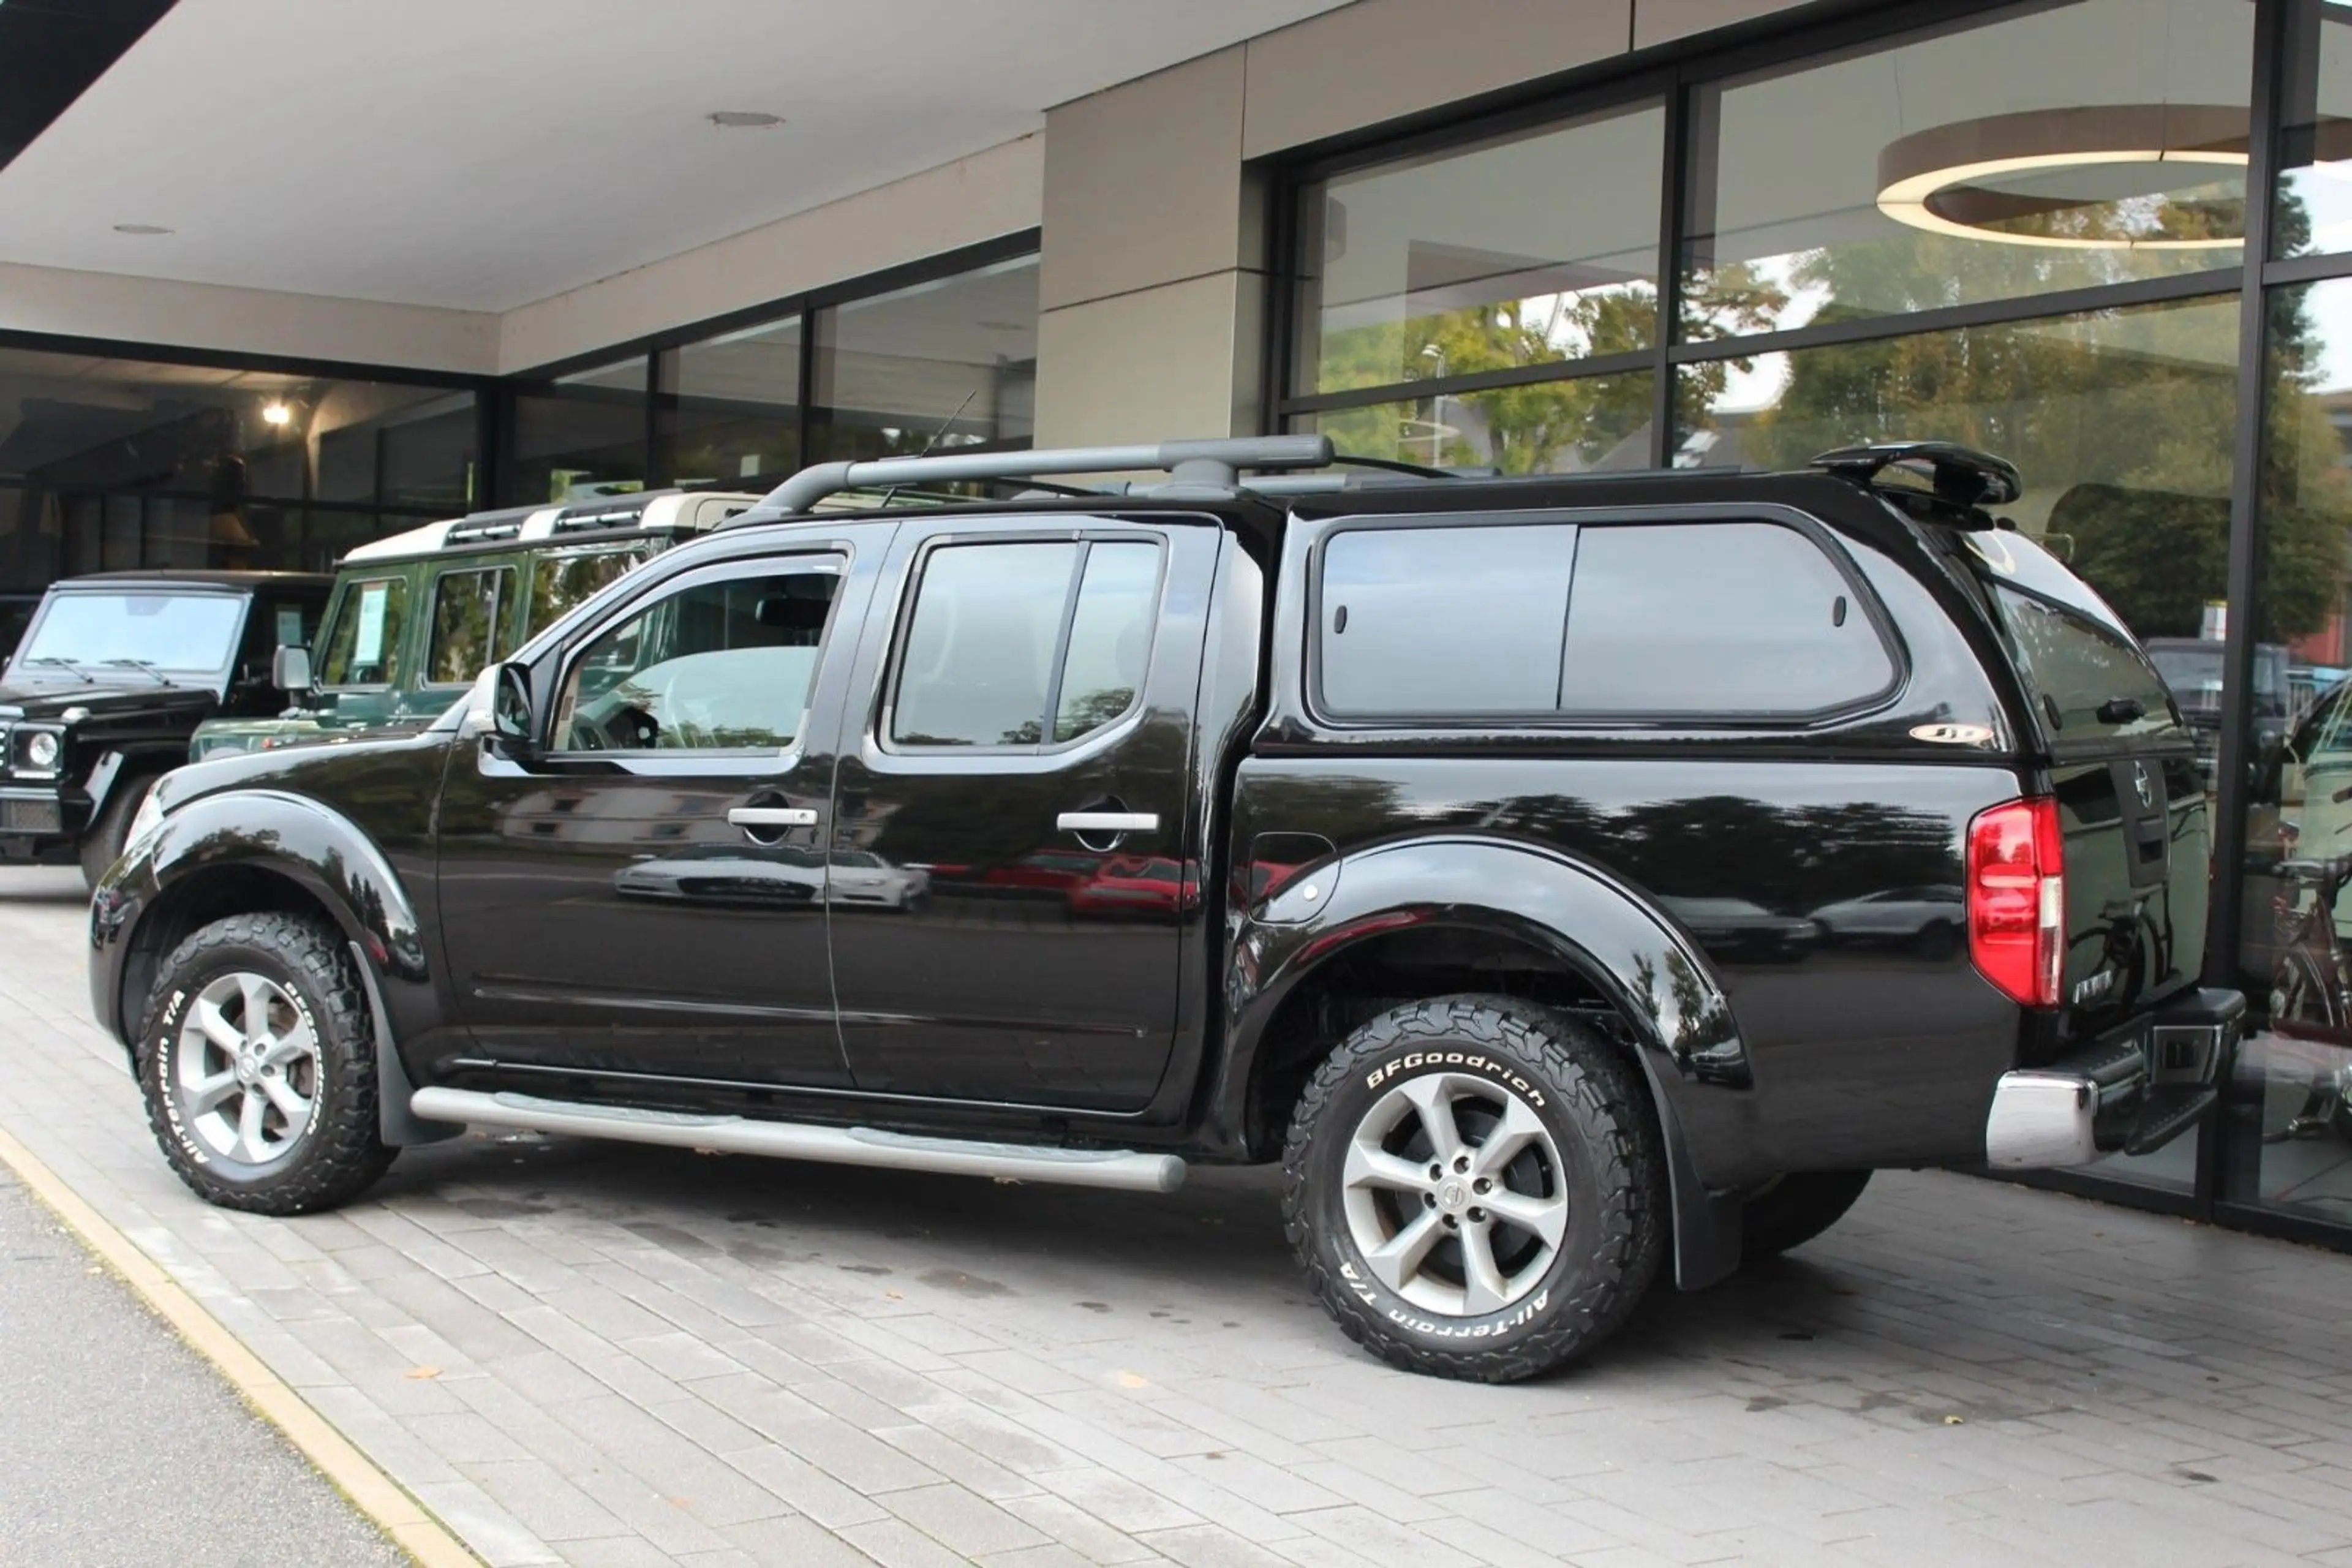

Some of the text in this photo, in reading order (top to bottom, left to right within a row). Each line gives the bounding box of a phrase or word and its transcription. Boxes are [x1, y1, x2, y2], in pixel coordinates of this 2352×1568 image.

[157, 989, 209, 1164] All-Terrain T/A
[1366, 1052, 1545, 1107] BFGoodrich
[1339, 1261, 1548, 1340] All-Terrain T/A
